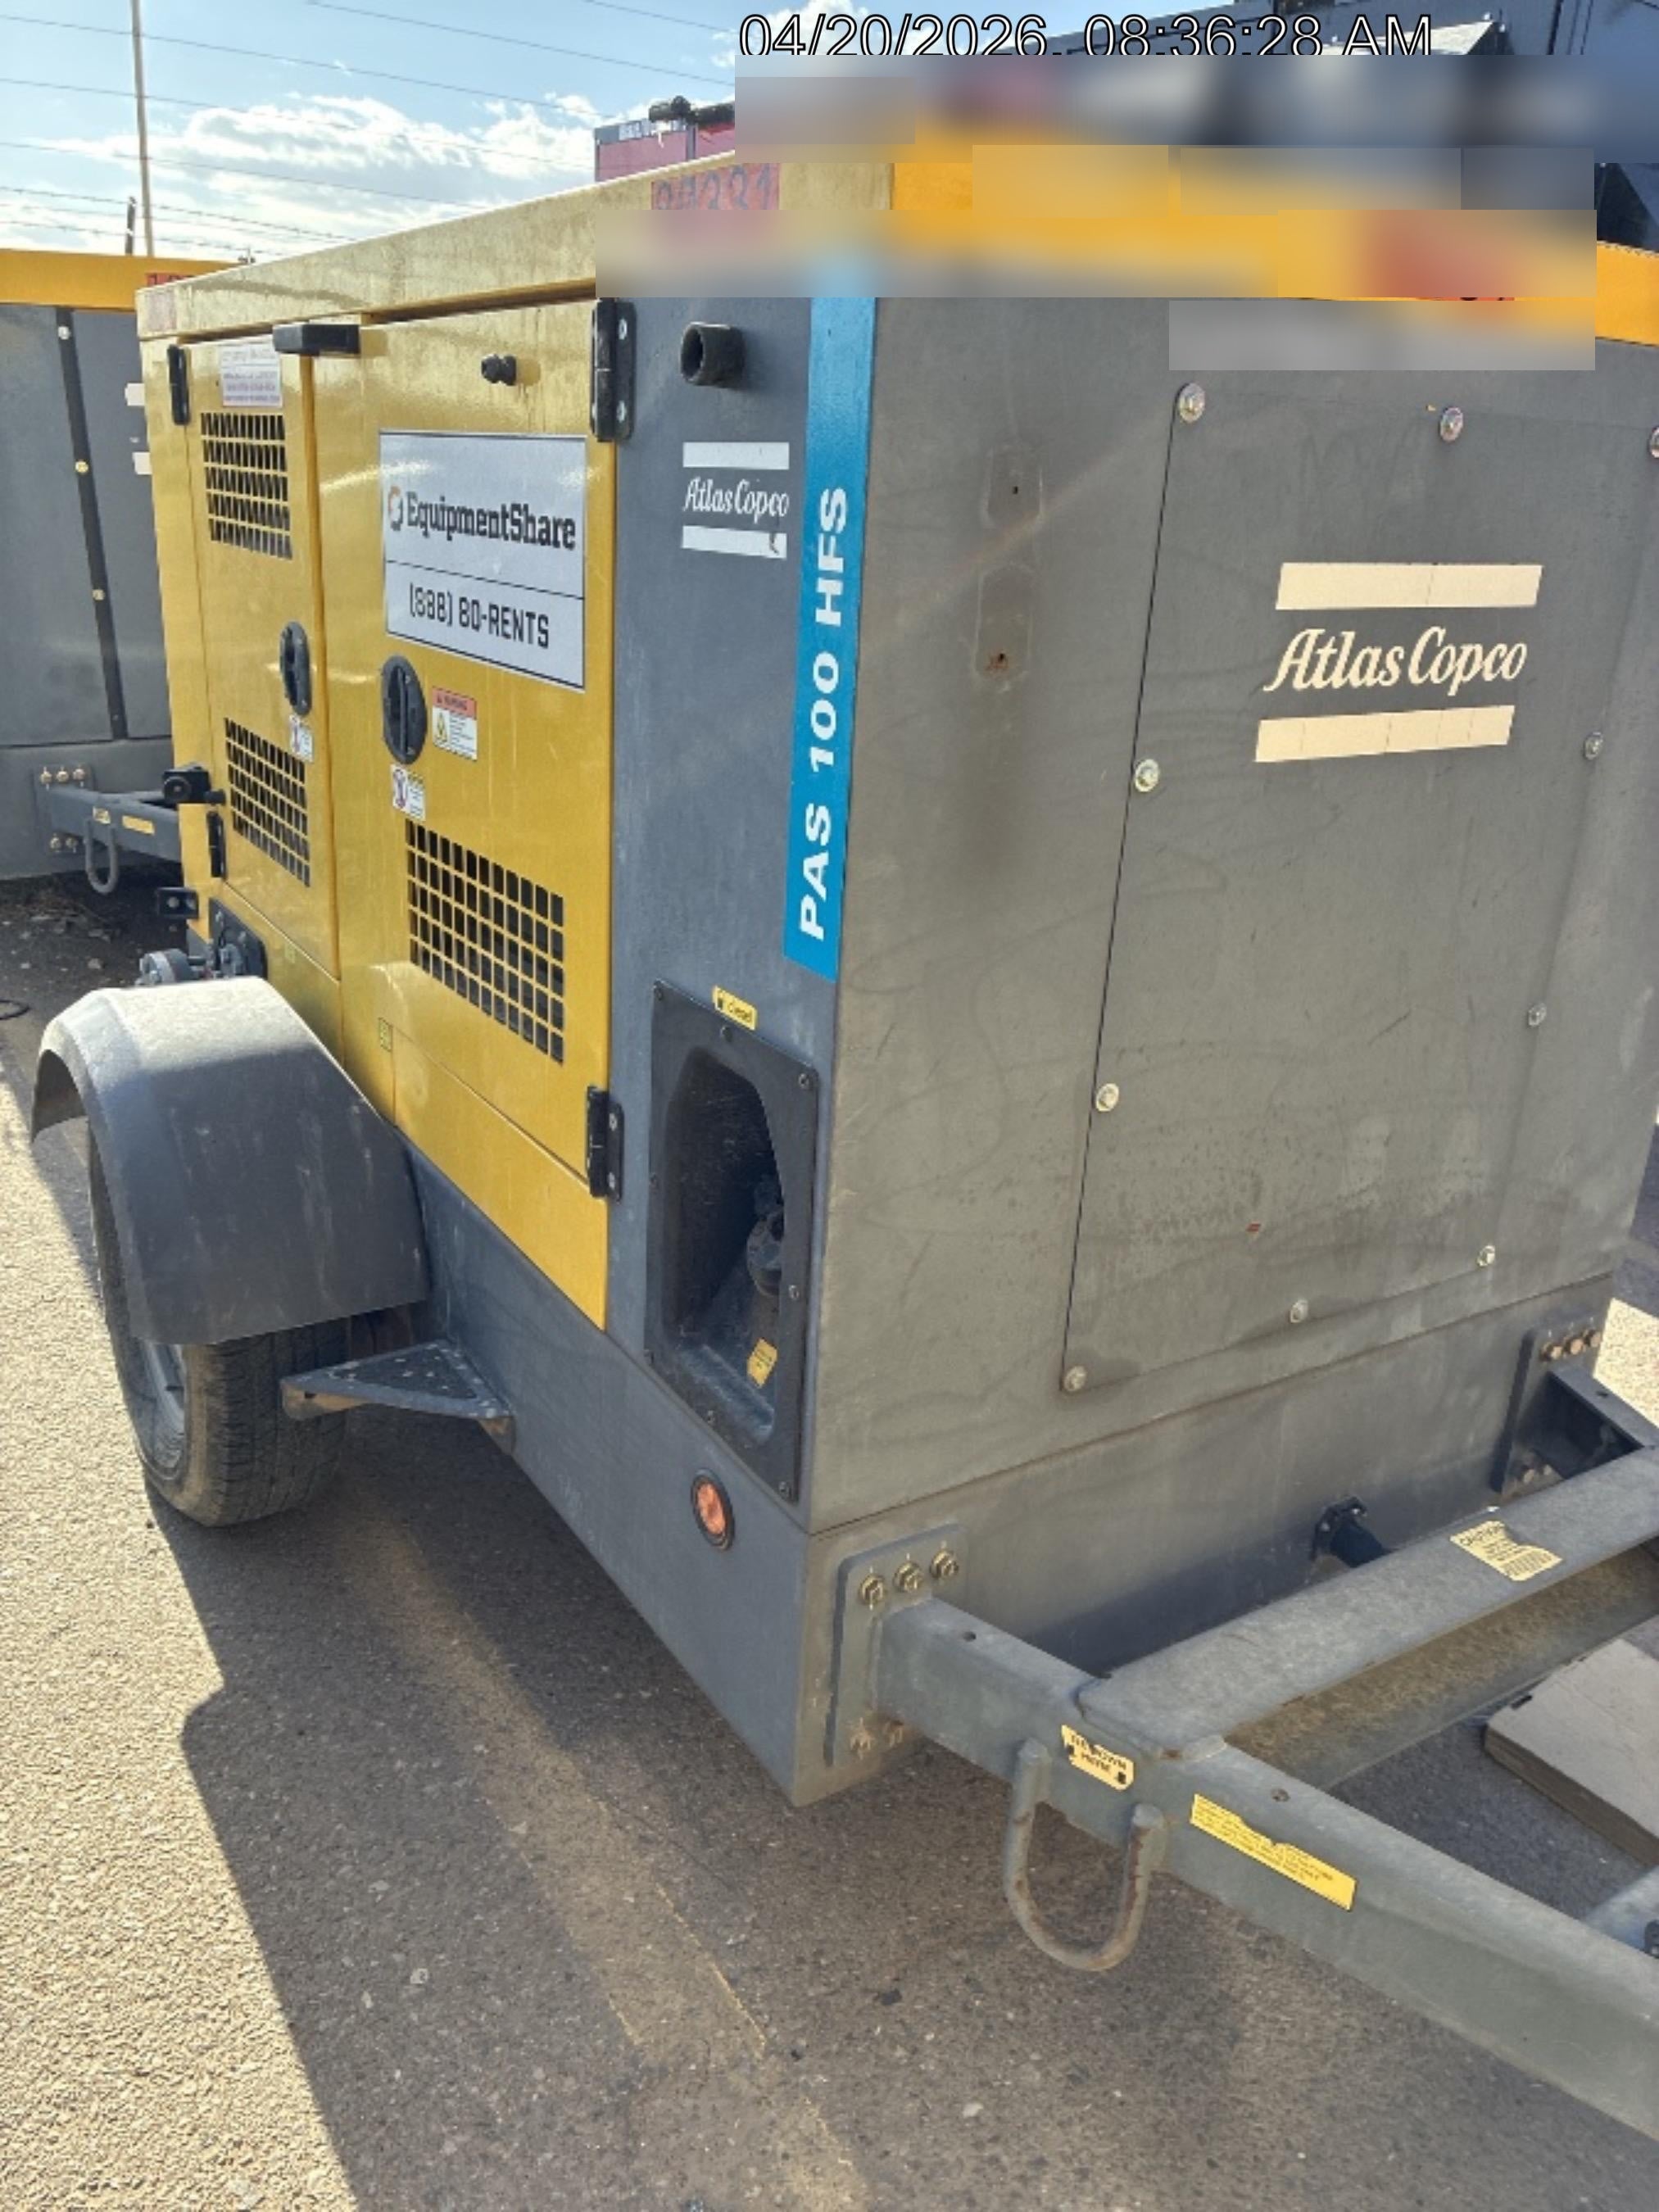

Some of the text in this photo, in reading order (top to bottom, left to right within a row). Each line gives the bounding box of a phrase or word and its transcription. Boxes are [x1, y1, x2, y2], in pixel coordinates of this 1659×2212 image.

[407, 492, 576, 551] EquipmentShare
[683, 475, 789, 524] Atlas Copco
[410, 582, 549, 649] (888) 80-RENTS
[1262, 625, 1528, 696] Atlas Copco
[799, 487, 847, 941] PAS 100 HFS
